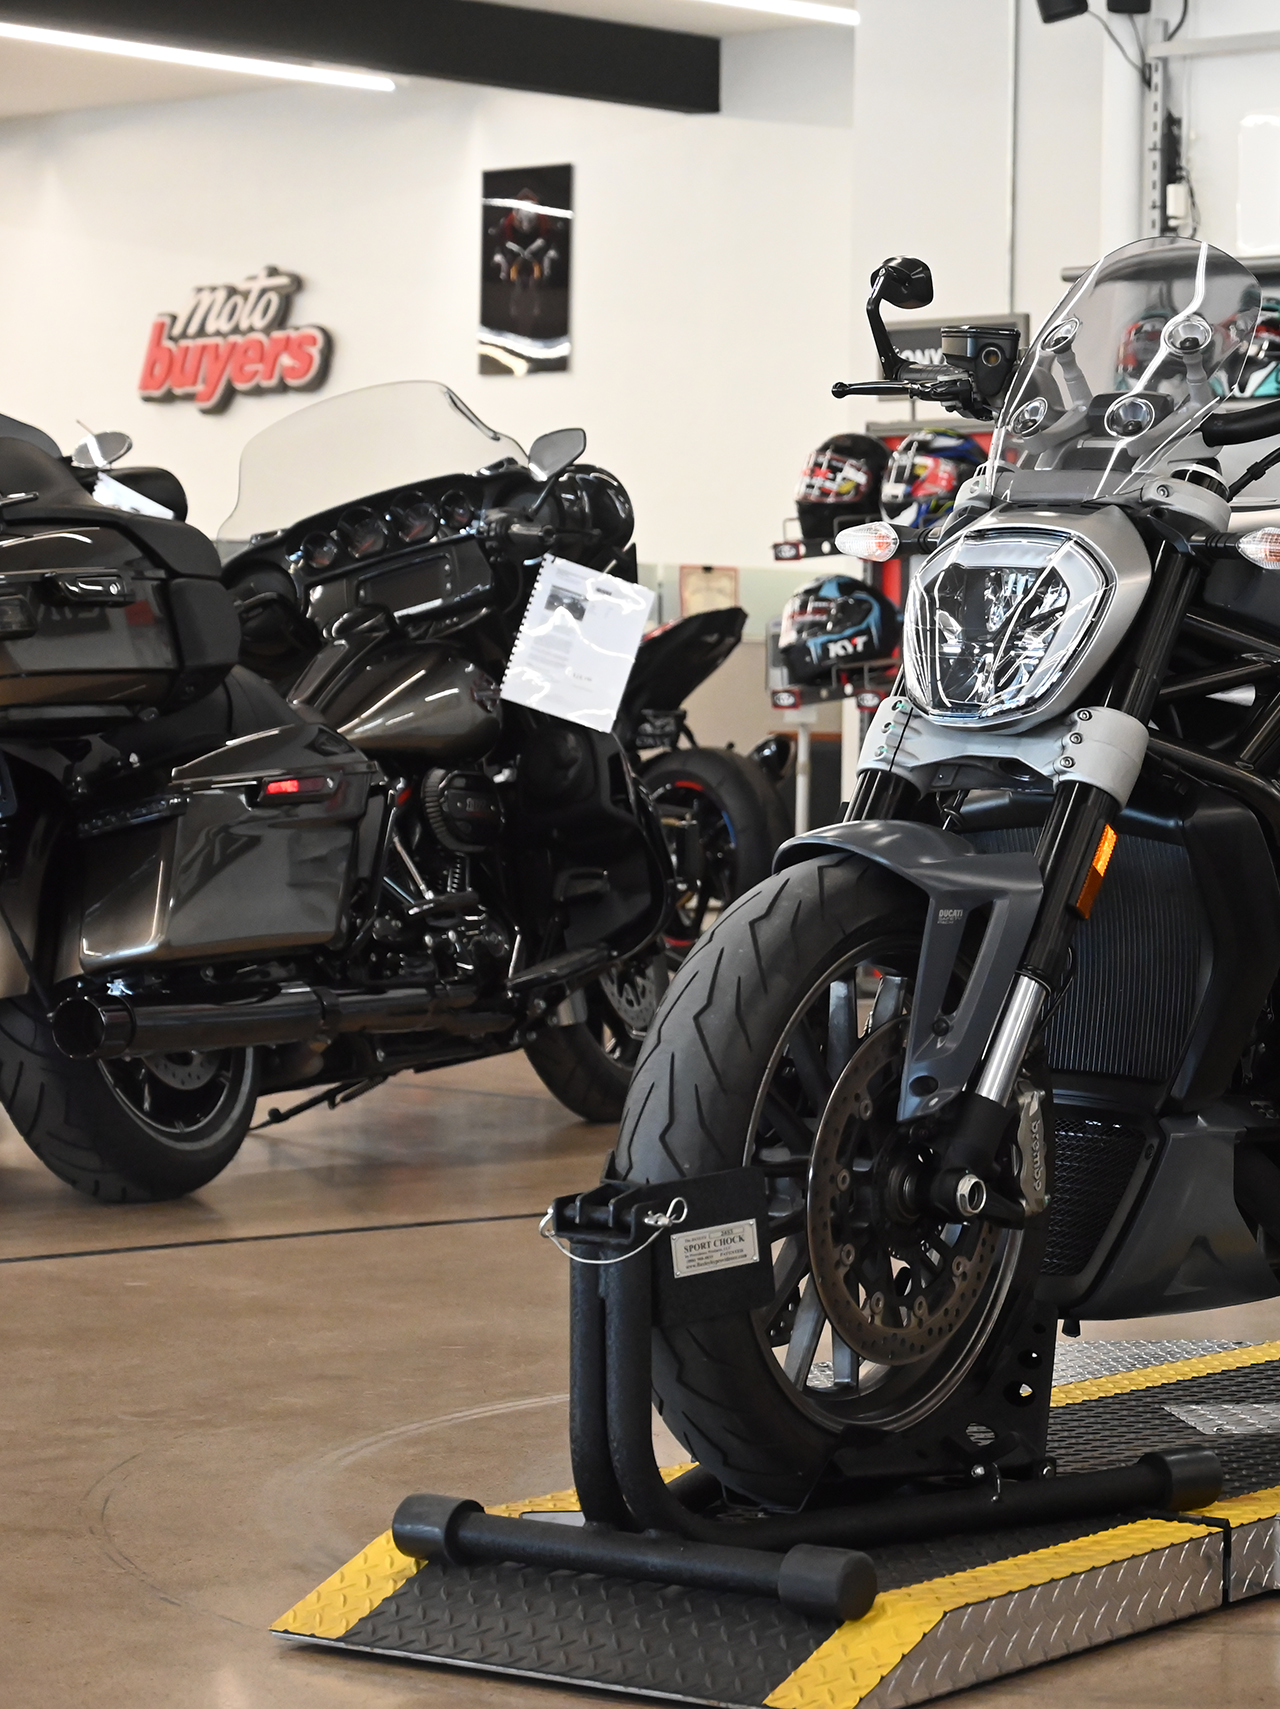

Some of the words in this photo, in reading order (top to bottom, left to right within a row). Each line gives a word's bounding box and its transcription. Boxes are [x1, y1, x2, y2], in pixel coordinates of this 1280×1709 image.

[138, 318, 322, 405] buyers
[827, 635, 868, 658] KYT
[939, 909, 963, 917] DUCATI
[1031, 1119, 1043, 1191] brembo
[684, 1241, 712, 1253] SPORT
[713, 1234, 746, 1247] CHOCK
